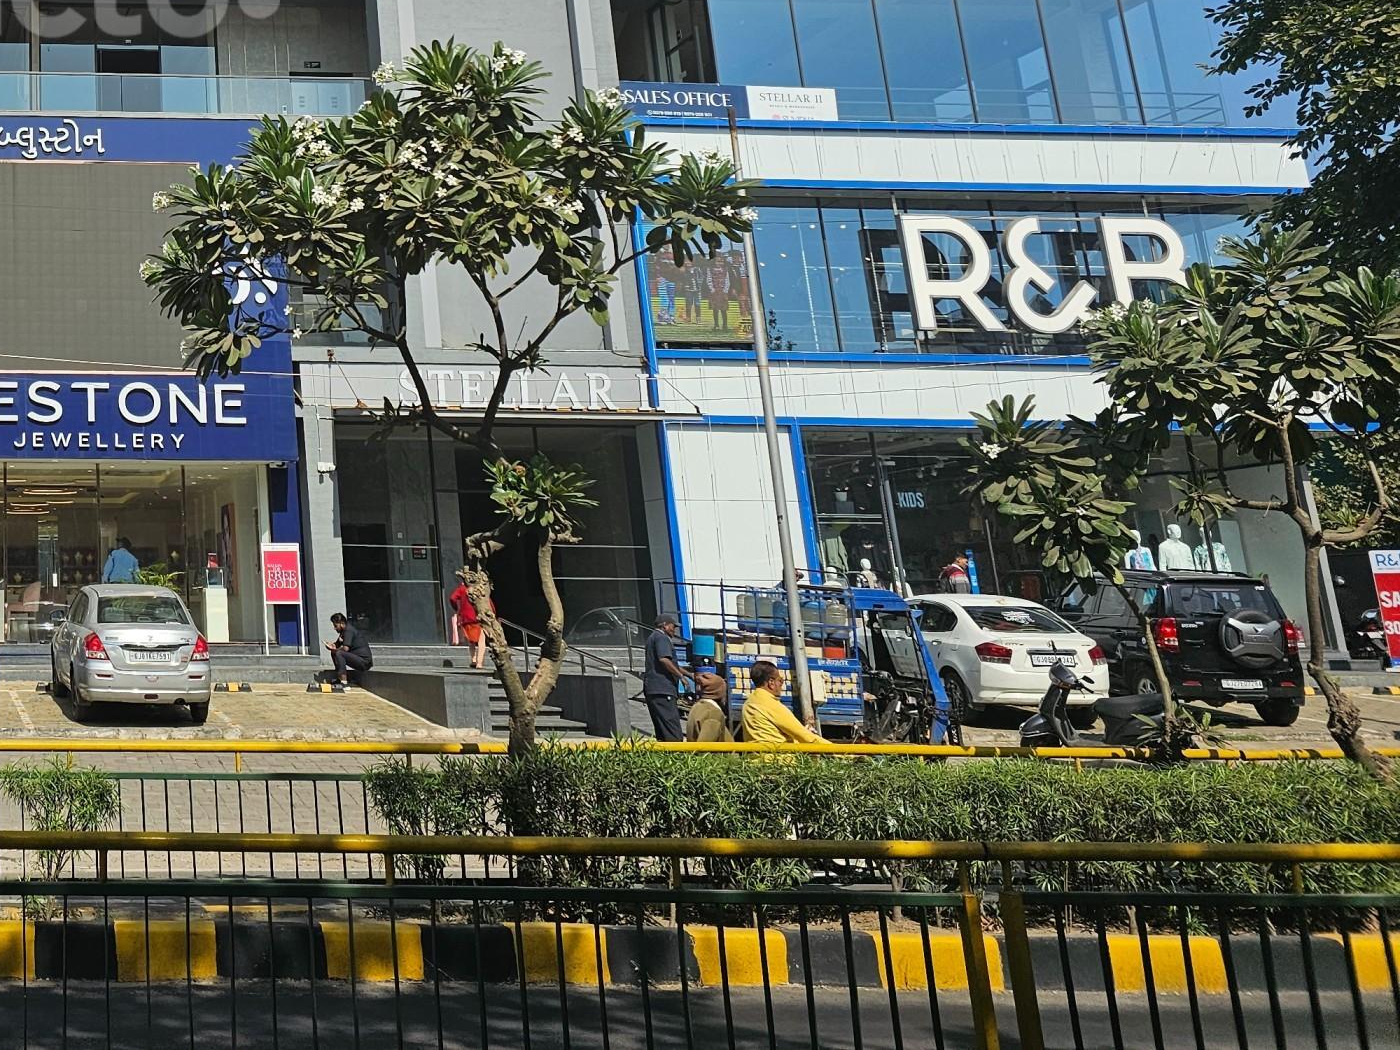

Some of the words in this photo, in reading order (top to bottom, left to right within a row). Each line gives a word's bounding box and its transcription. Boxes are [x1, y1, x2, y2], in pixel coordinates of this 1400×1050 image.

[624, 89, 672, 104] SALES
[674, 91, 733, 107] OFFICE
[759, 92, 810, 103] STELLAR
[13, 432, 185, 450] JEWELLERY
[897, 492, 925, 508] KIDS
[1375, 553, 1400, 567] R&
[268, 570, 297, 580] FREE
[267, 580, 297, 589] GOLD
